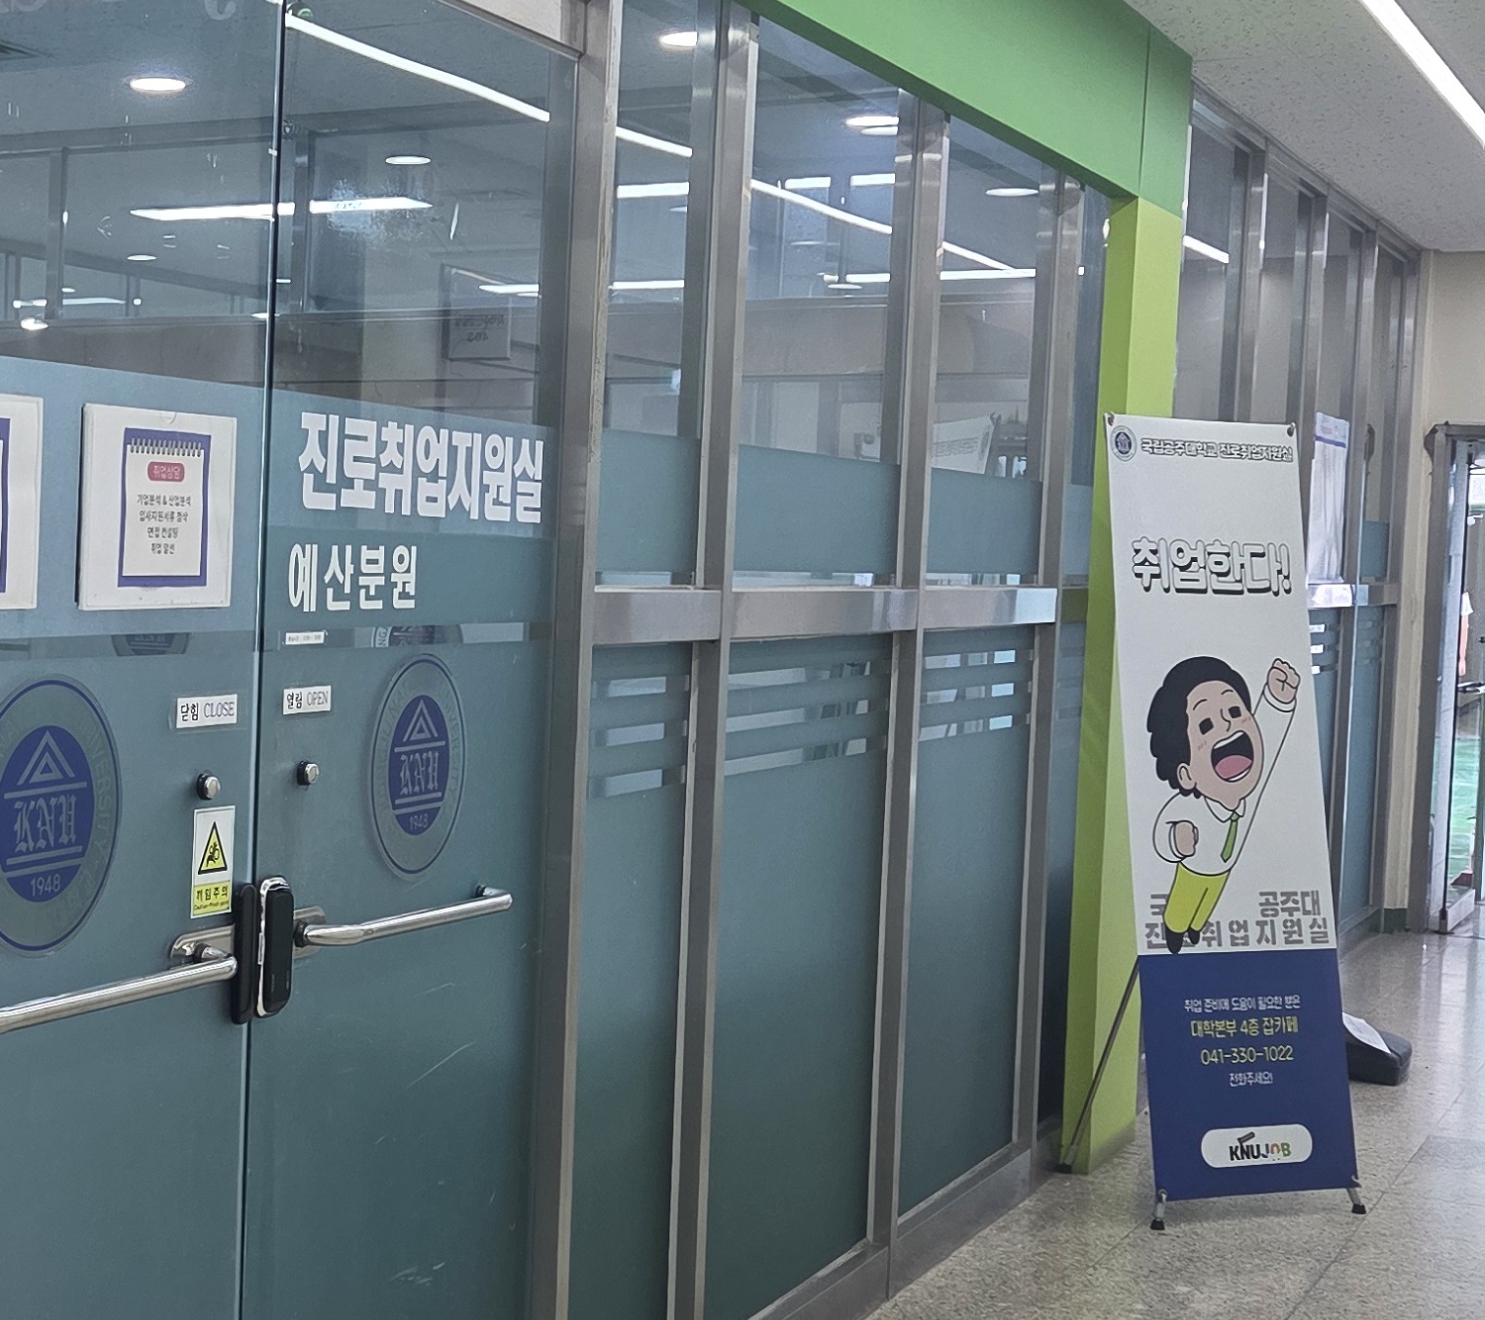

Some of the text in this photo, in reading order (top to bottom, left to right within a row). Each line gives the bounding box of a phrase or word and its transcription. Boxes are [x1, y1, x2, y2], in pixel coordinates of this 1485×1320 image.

[299, 412, 544, 523] 진로취업지원실
[288, 543, 417, 612] 예산분원
[1132, 536, 1291, 596] 취업한다!
[180, 701, 235, 721] 닫힘 CLOSE
[286, 690, 329, 709] 열림 OPEN
[30, 873, 61, 896] 1948
[1259, 890, 1321, 918] 공주대
[1145, 917, 1329, 949] 진취업지원실
[1191, 1016, 1299, 1038] 대학본부 4층 잡카페
[1201, 1045, 1294, 1065] 041-330-1022
